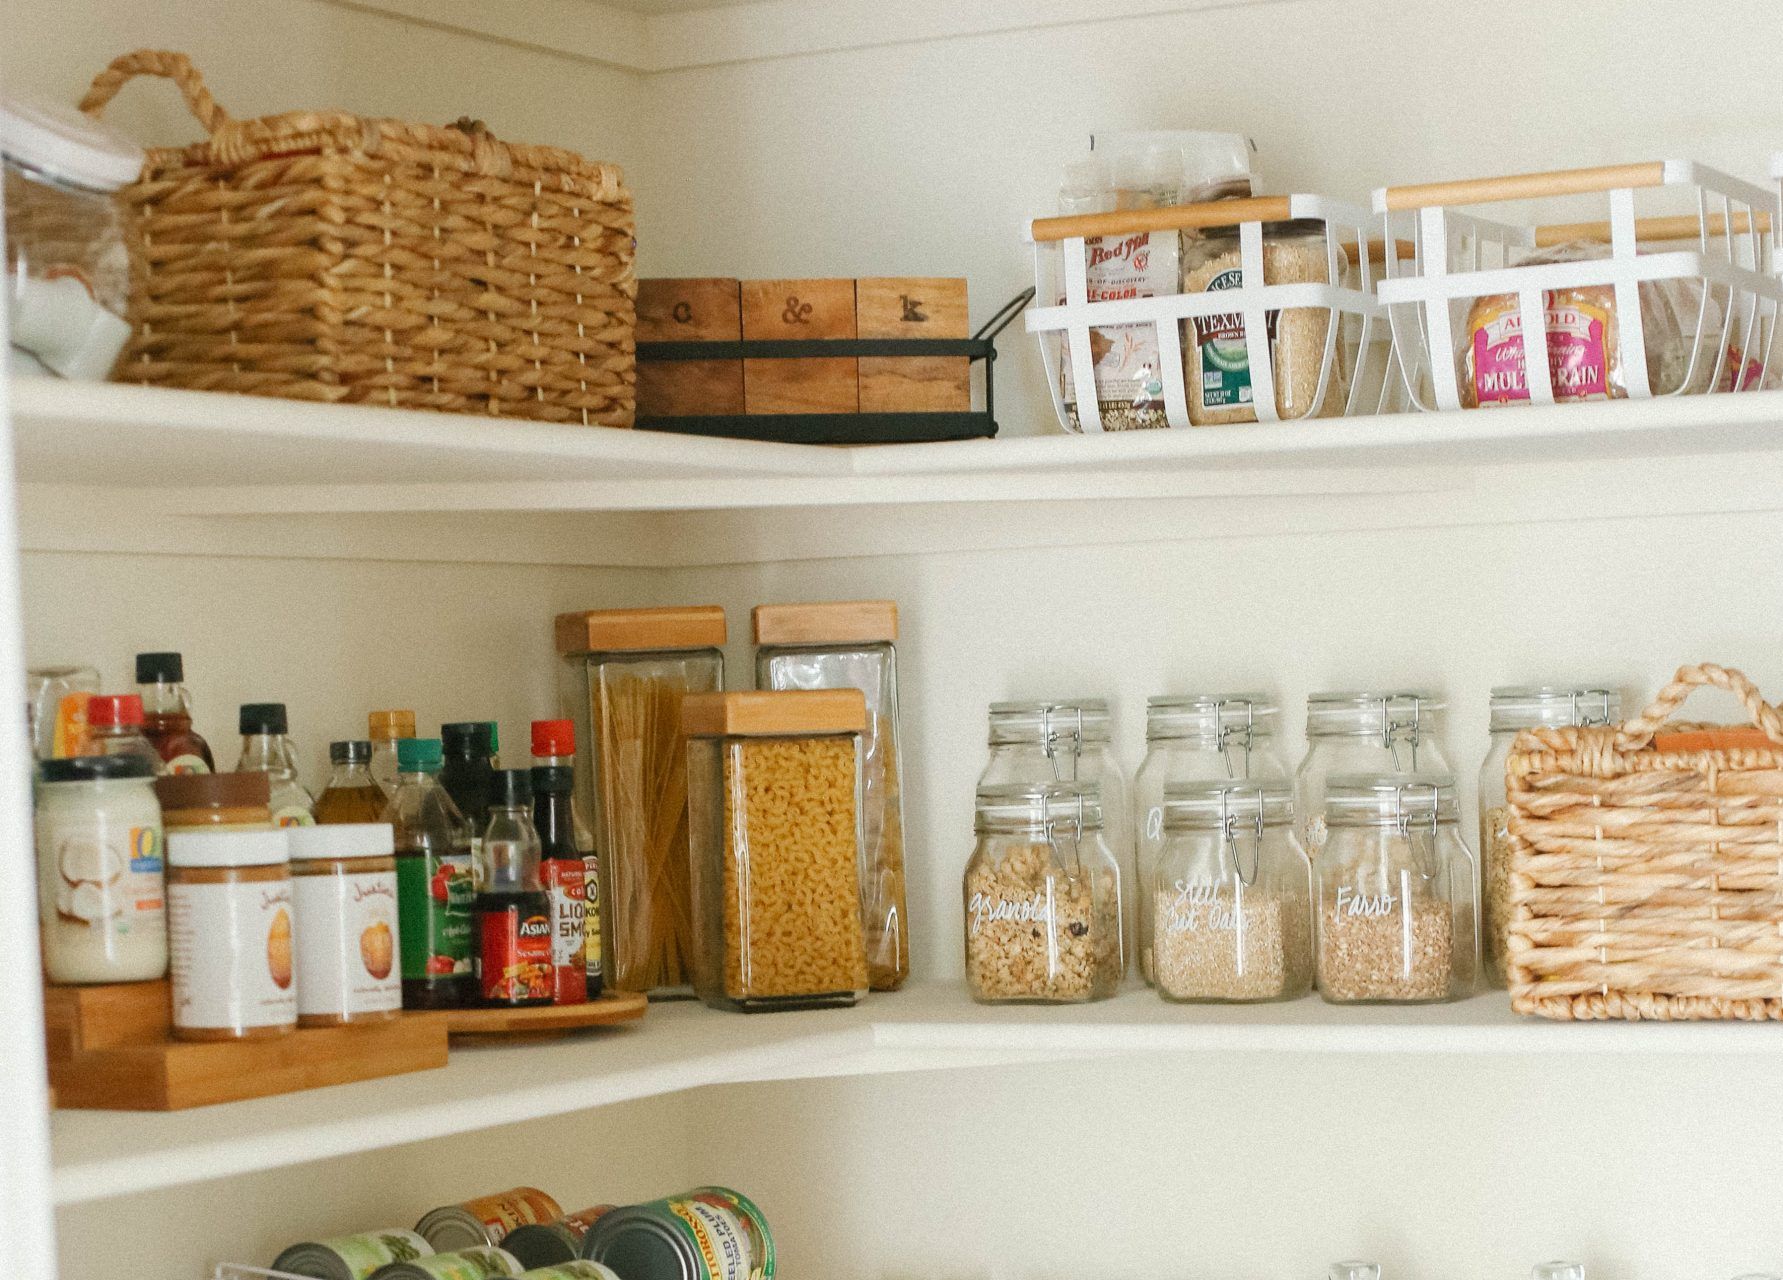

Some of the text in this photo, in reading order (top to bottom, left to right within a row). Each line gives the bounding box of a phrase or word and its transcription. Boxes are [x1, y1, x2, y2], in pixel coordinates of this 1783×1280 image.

[1089, 240, 1124, 268] Red
[781, 295, 813, 325] &
[899, 294, 930, 322] k
[559, 903, 585, 919] LIQ
[695, 1205, 726, 1237] PLUM
